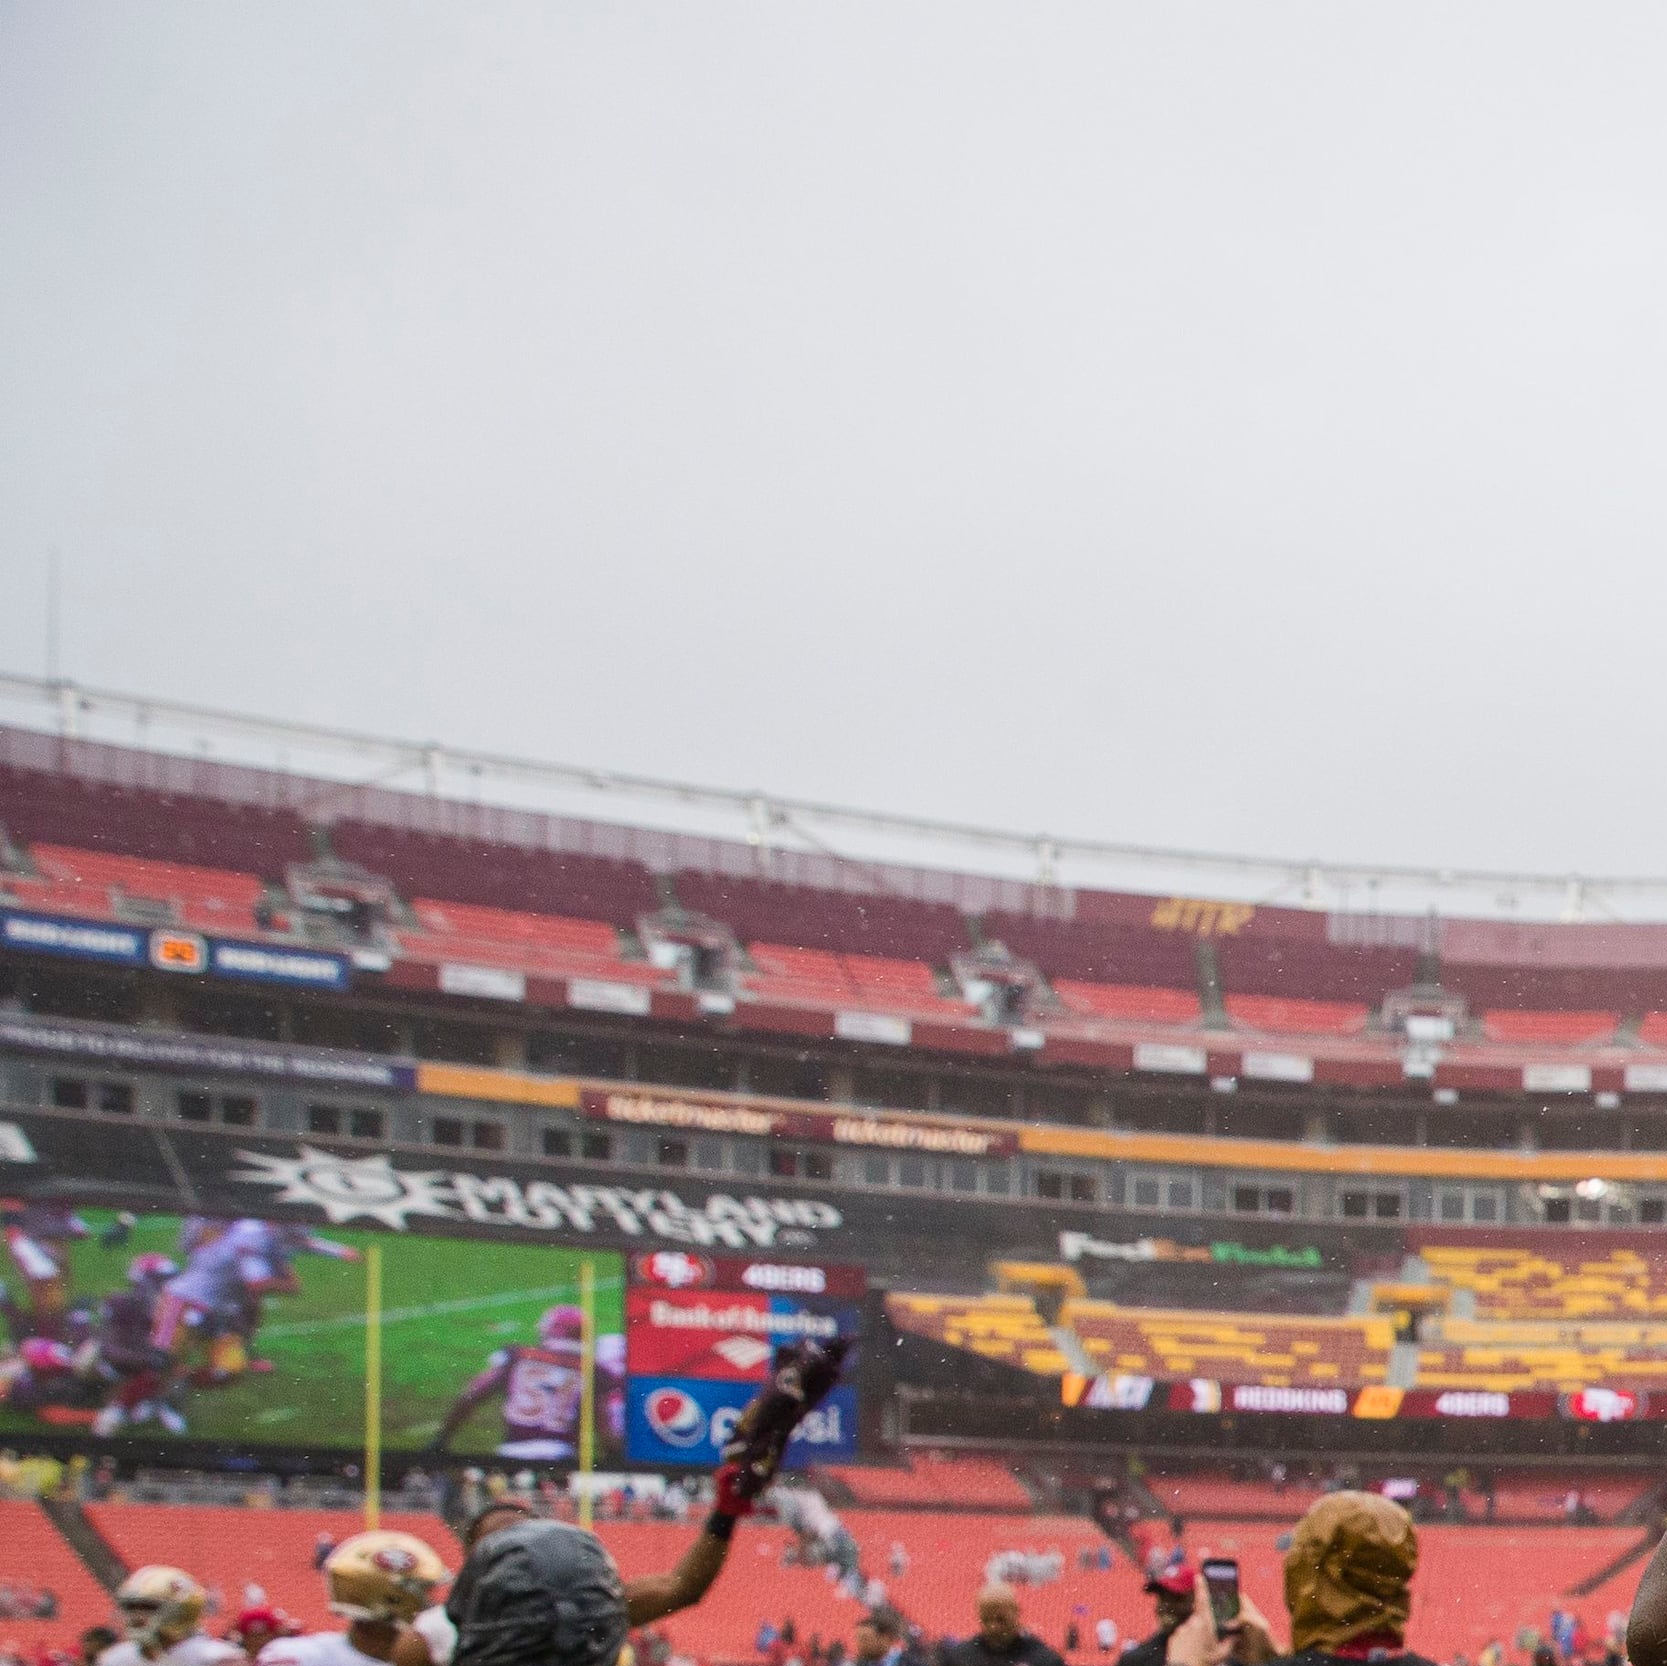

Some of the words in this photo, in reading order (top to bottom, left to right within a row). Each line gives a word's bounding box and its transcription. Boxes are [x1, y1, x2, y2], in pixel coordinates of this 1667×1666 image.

[450, 1172, 843, 1229] MARYLAND
[741, 1263, 826, 1293] 49ERS
[1233, 1387, 1348, 1416] REDSKINS
[1435, 1391, 1510, 1417] 49ERS
